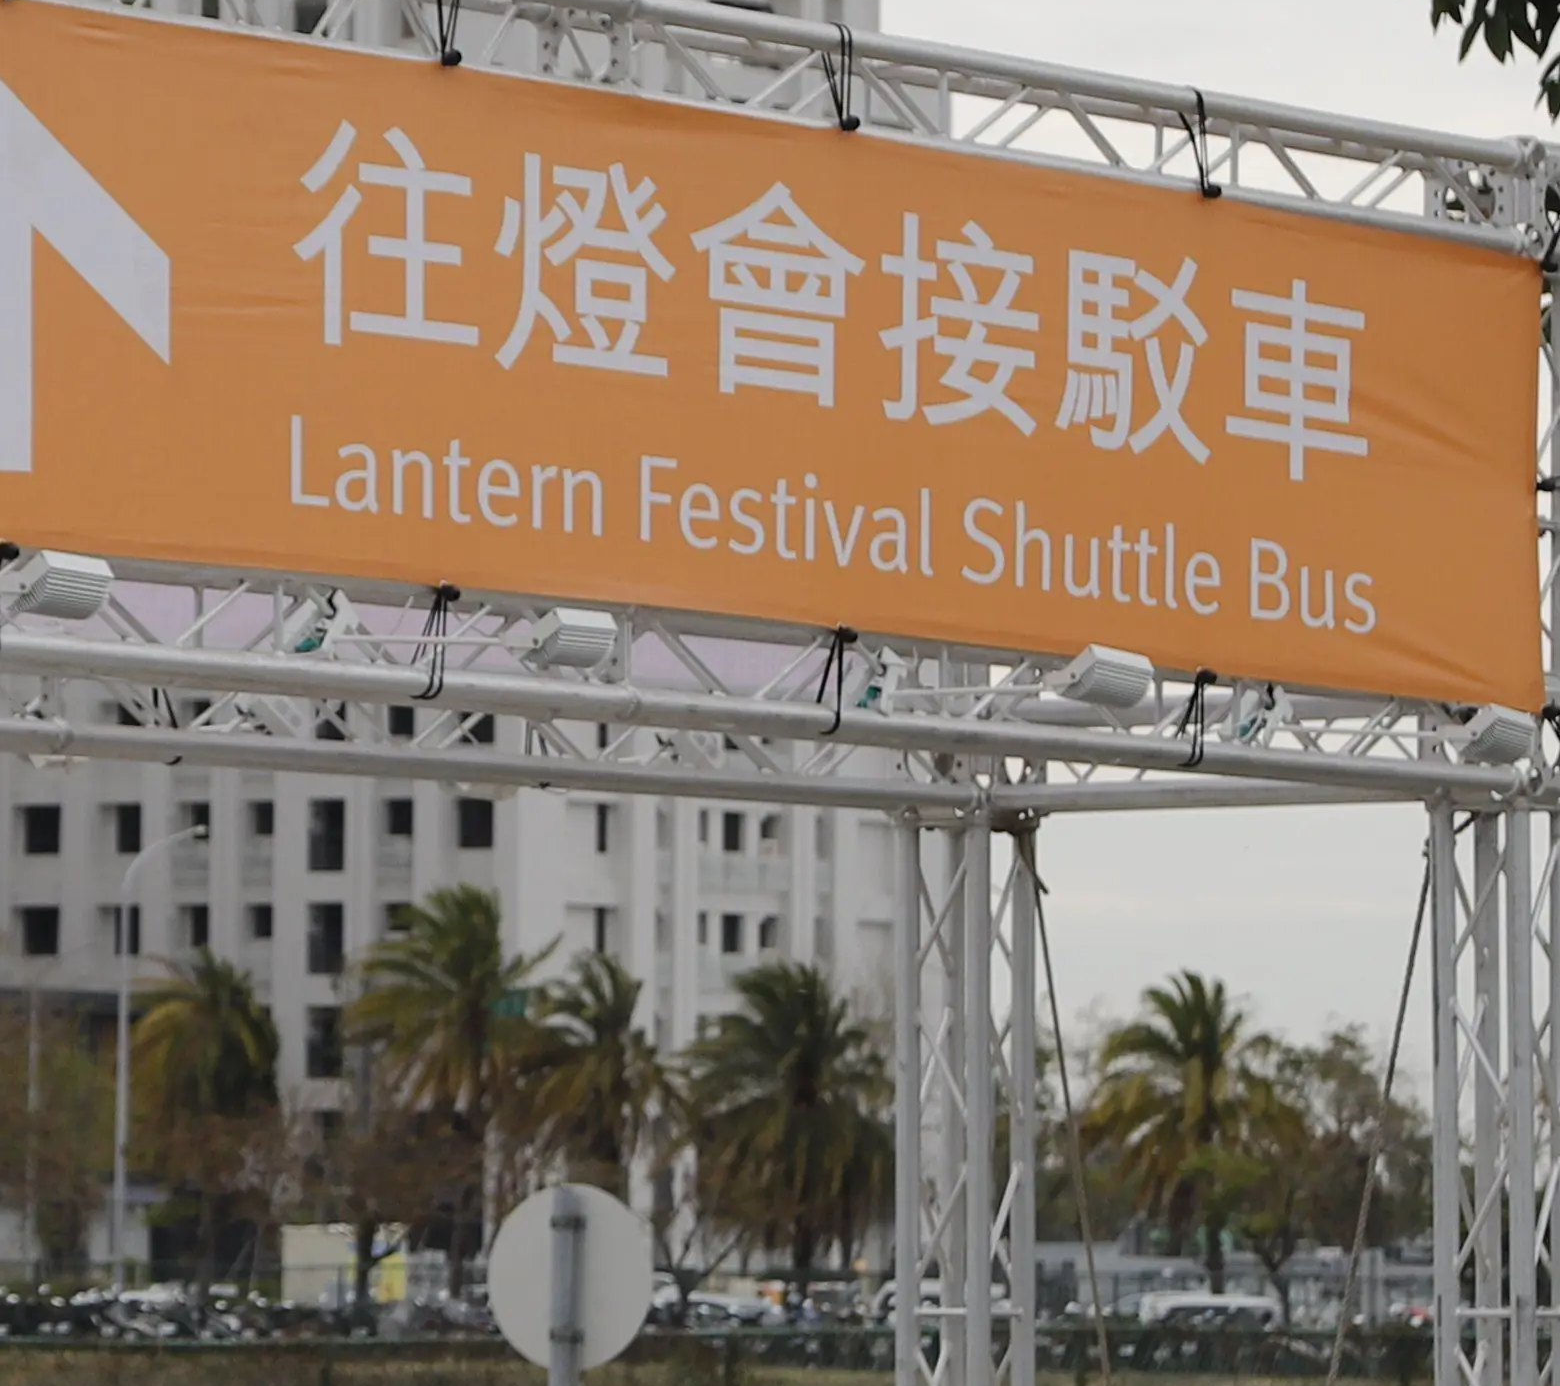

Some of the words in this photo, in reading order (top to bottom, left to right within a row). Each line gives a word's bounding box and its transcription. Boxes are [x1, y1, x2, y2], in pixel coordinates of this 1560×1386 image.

[292, 119, 1368, 481] 往燈會接駁車
[290, 414, 604, 537] Lantern
[638, 455, 934, 578] Festival
[960, 497, 1222, 616] Shuttle
[1250, 537, 1377, 634] Bus
